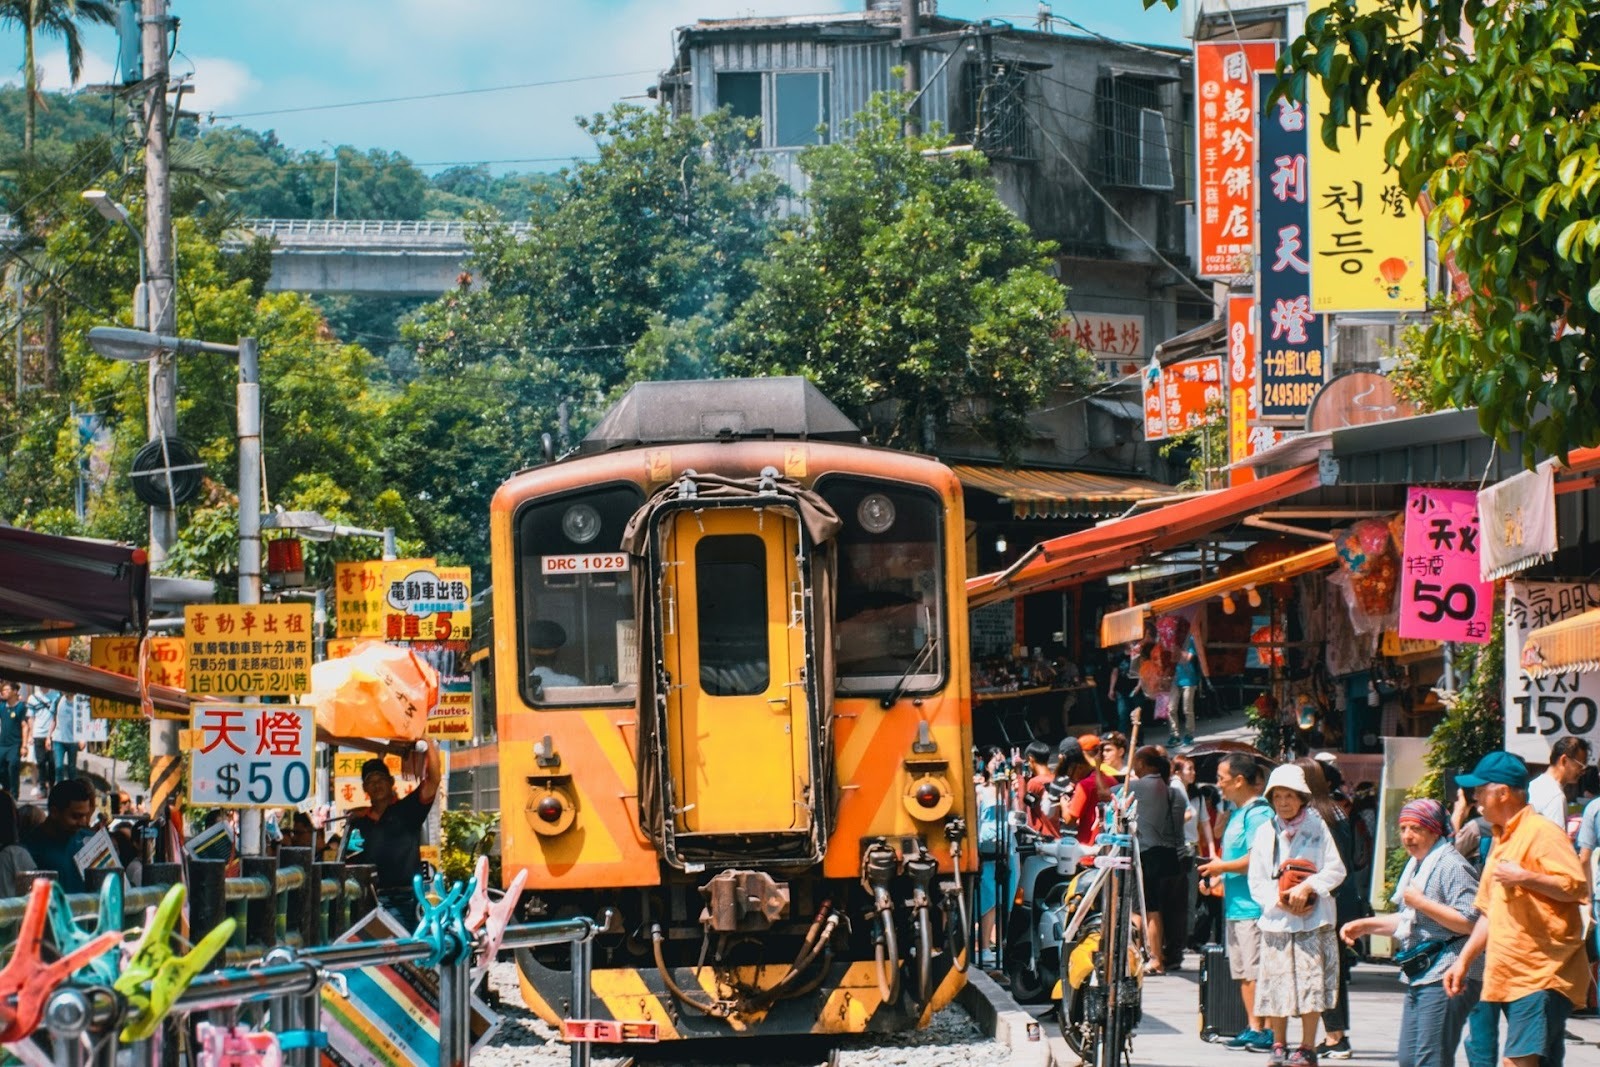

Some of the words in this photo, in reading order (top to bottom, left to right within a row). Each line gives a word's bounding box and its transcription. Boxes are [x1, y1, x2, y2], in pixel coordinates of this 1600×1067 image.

[548, 558, 577, 570] DRC
[583, 556, 625, 569] 1029
[340, 568, 383, 595] 電動
[391, 581, 464, 601] 電動車出租
[1414, 579, 1477, 623] 50
[191, 611, 305, 636] 電動車出租
[434, 706, 470, 715] inutes.
[1513, 697, 1598, 735] 150
[200, 711, 302, 755] 天燈
[216, 761, 311, 803] $50
